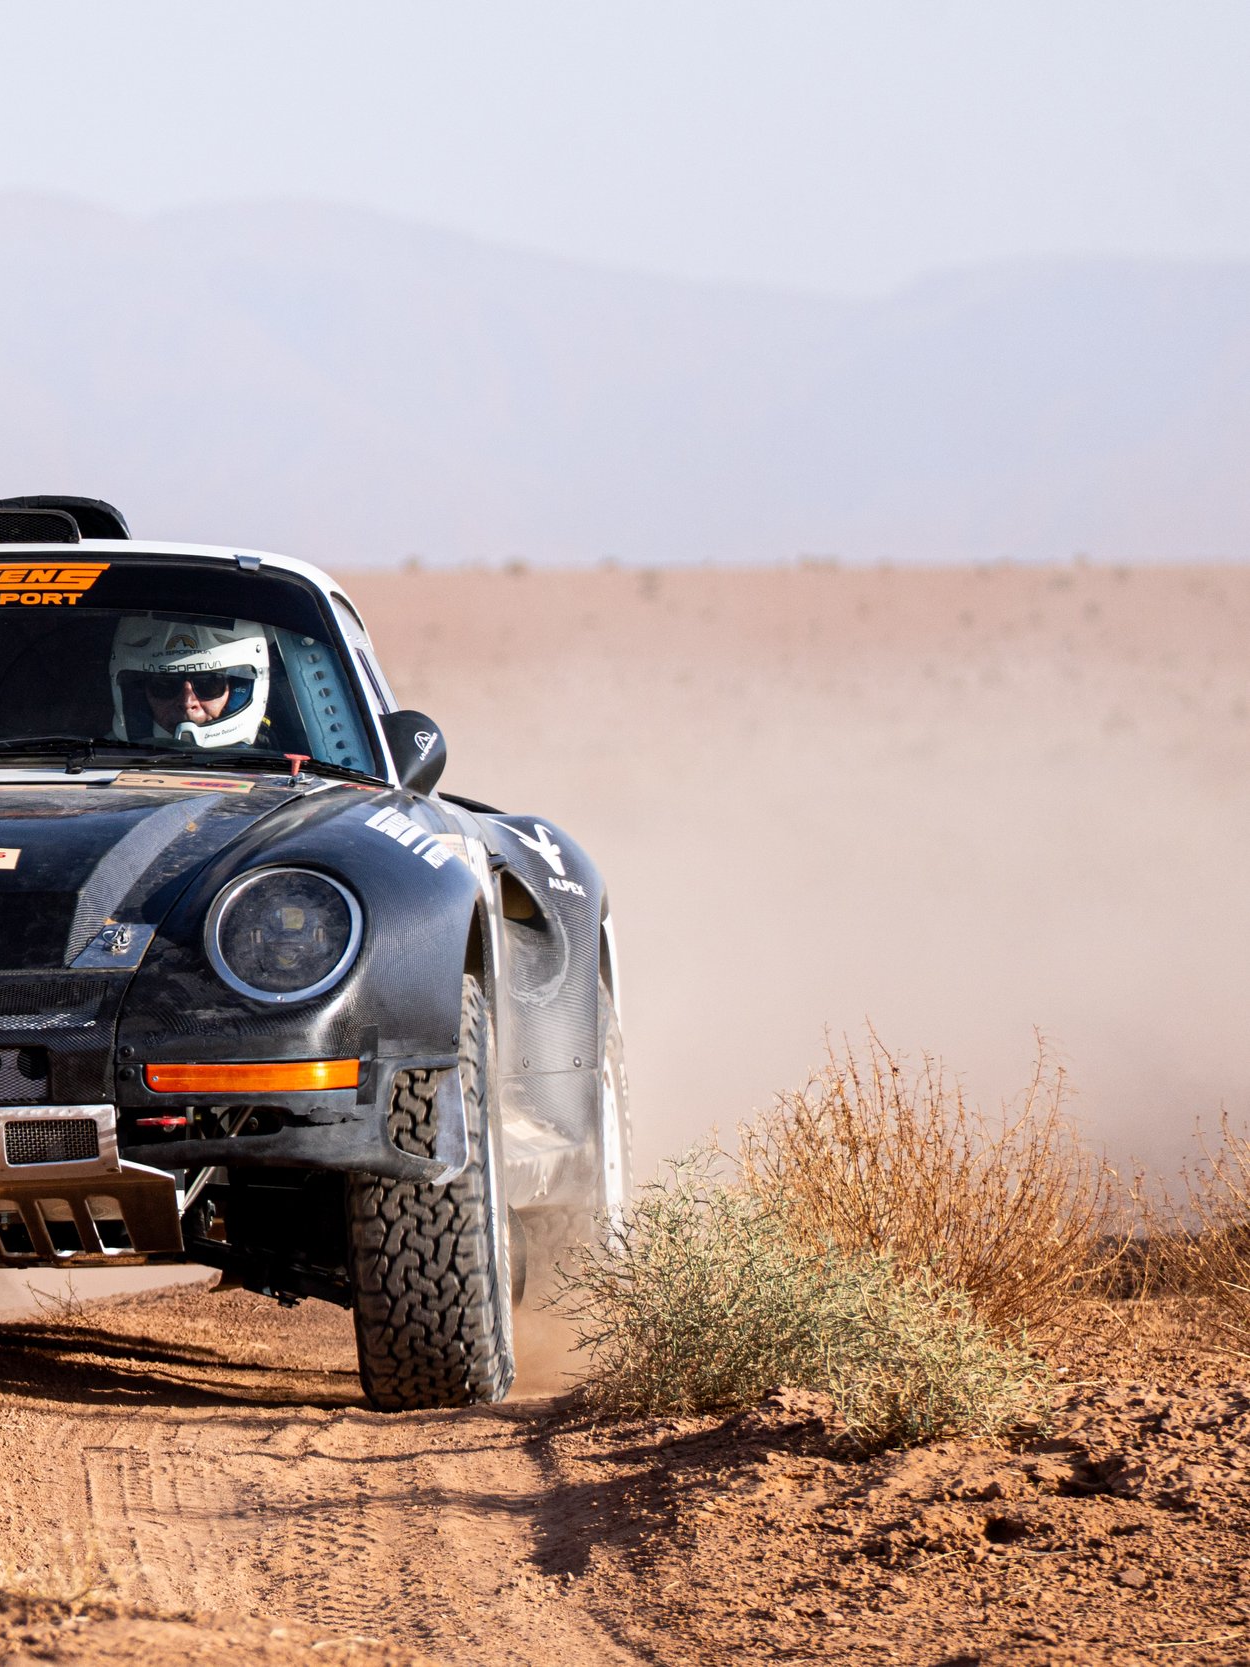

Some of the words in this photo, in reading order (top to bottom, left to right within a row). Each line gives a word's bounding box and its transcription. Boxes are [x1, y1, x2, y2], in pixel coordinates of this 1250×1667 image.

[142, 663, 155, 671] LA
[158, 660, 222, 672] SPORTIVA
[548, 877, 587, 897] ALPEX
